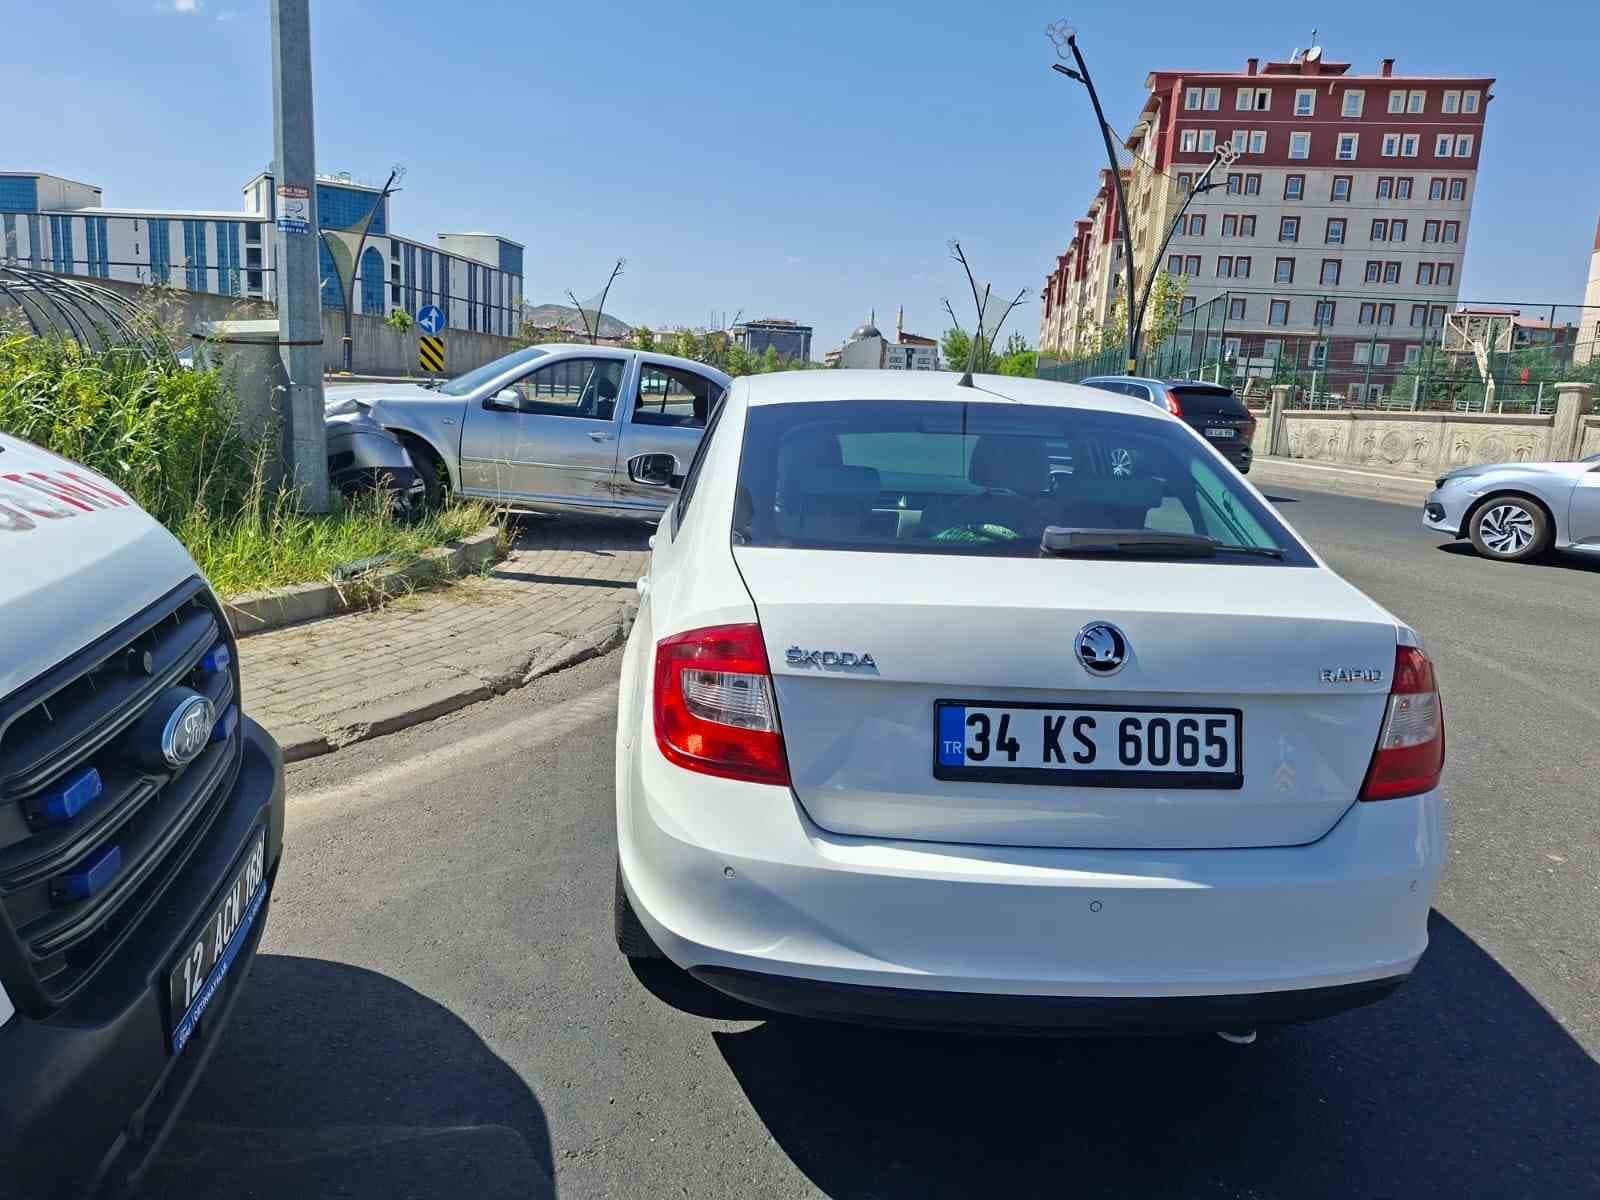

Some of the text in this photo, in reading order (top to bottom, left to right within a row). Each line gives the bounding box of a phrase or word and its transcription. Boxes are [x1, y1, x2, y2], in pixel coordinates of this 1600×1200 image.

[1319, 668, 1383, 683] RAPID
[182, 704, 209, 751] Ford
[943, 740, 962, 754] TR
[965, 713, 1228, 767] 34 KS 6065
[184, 942, 203, 1008] 12
